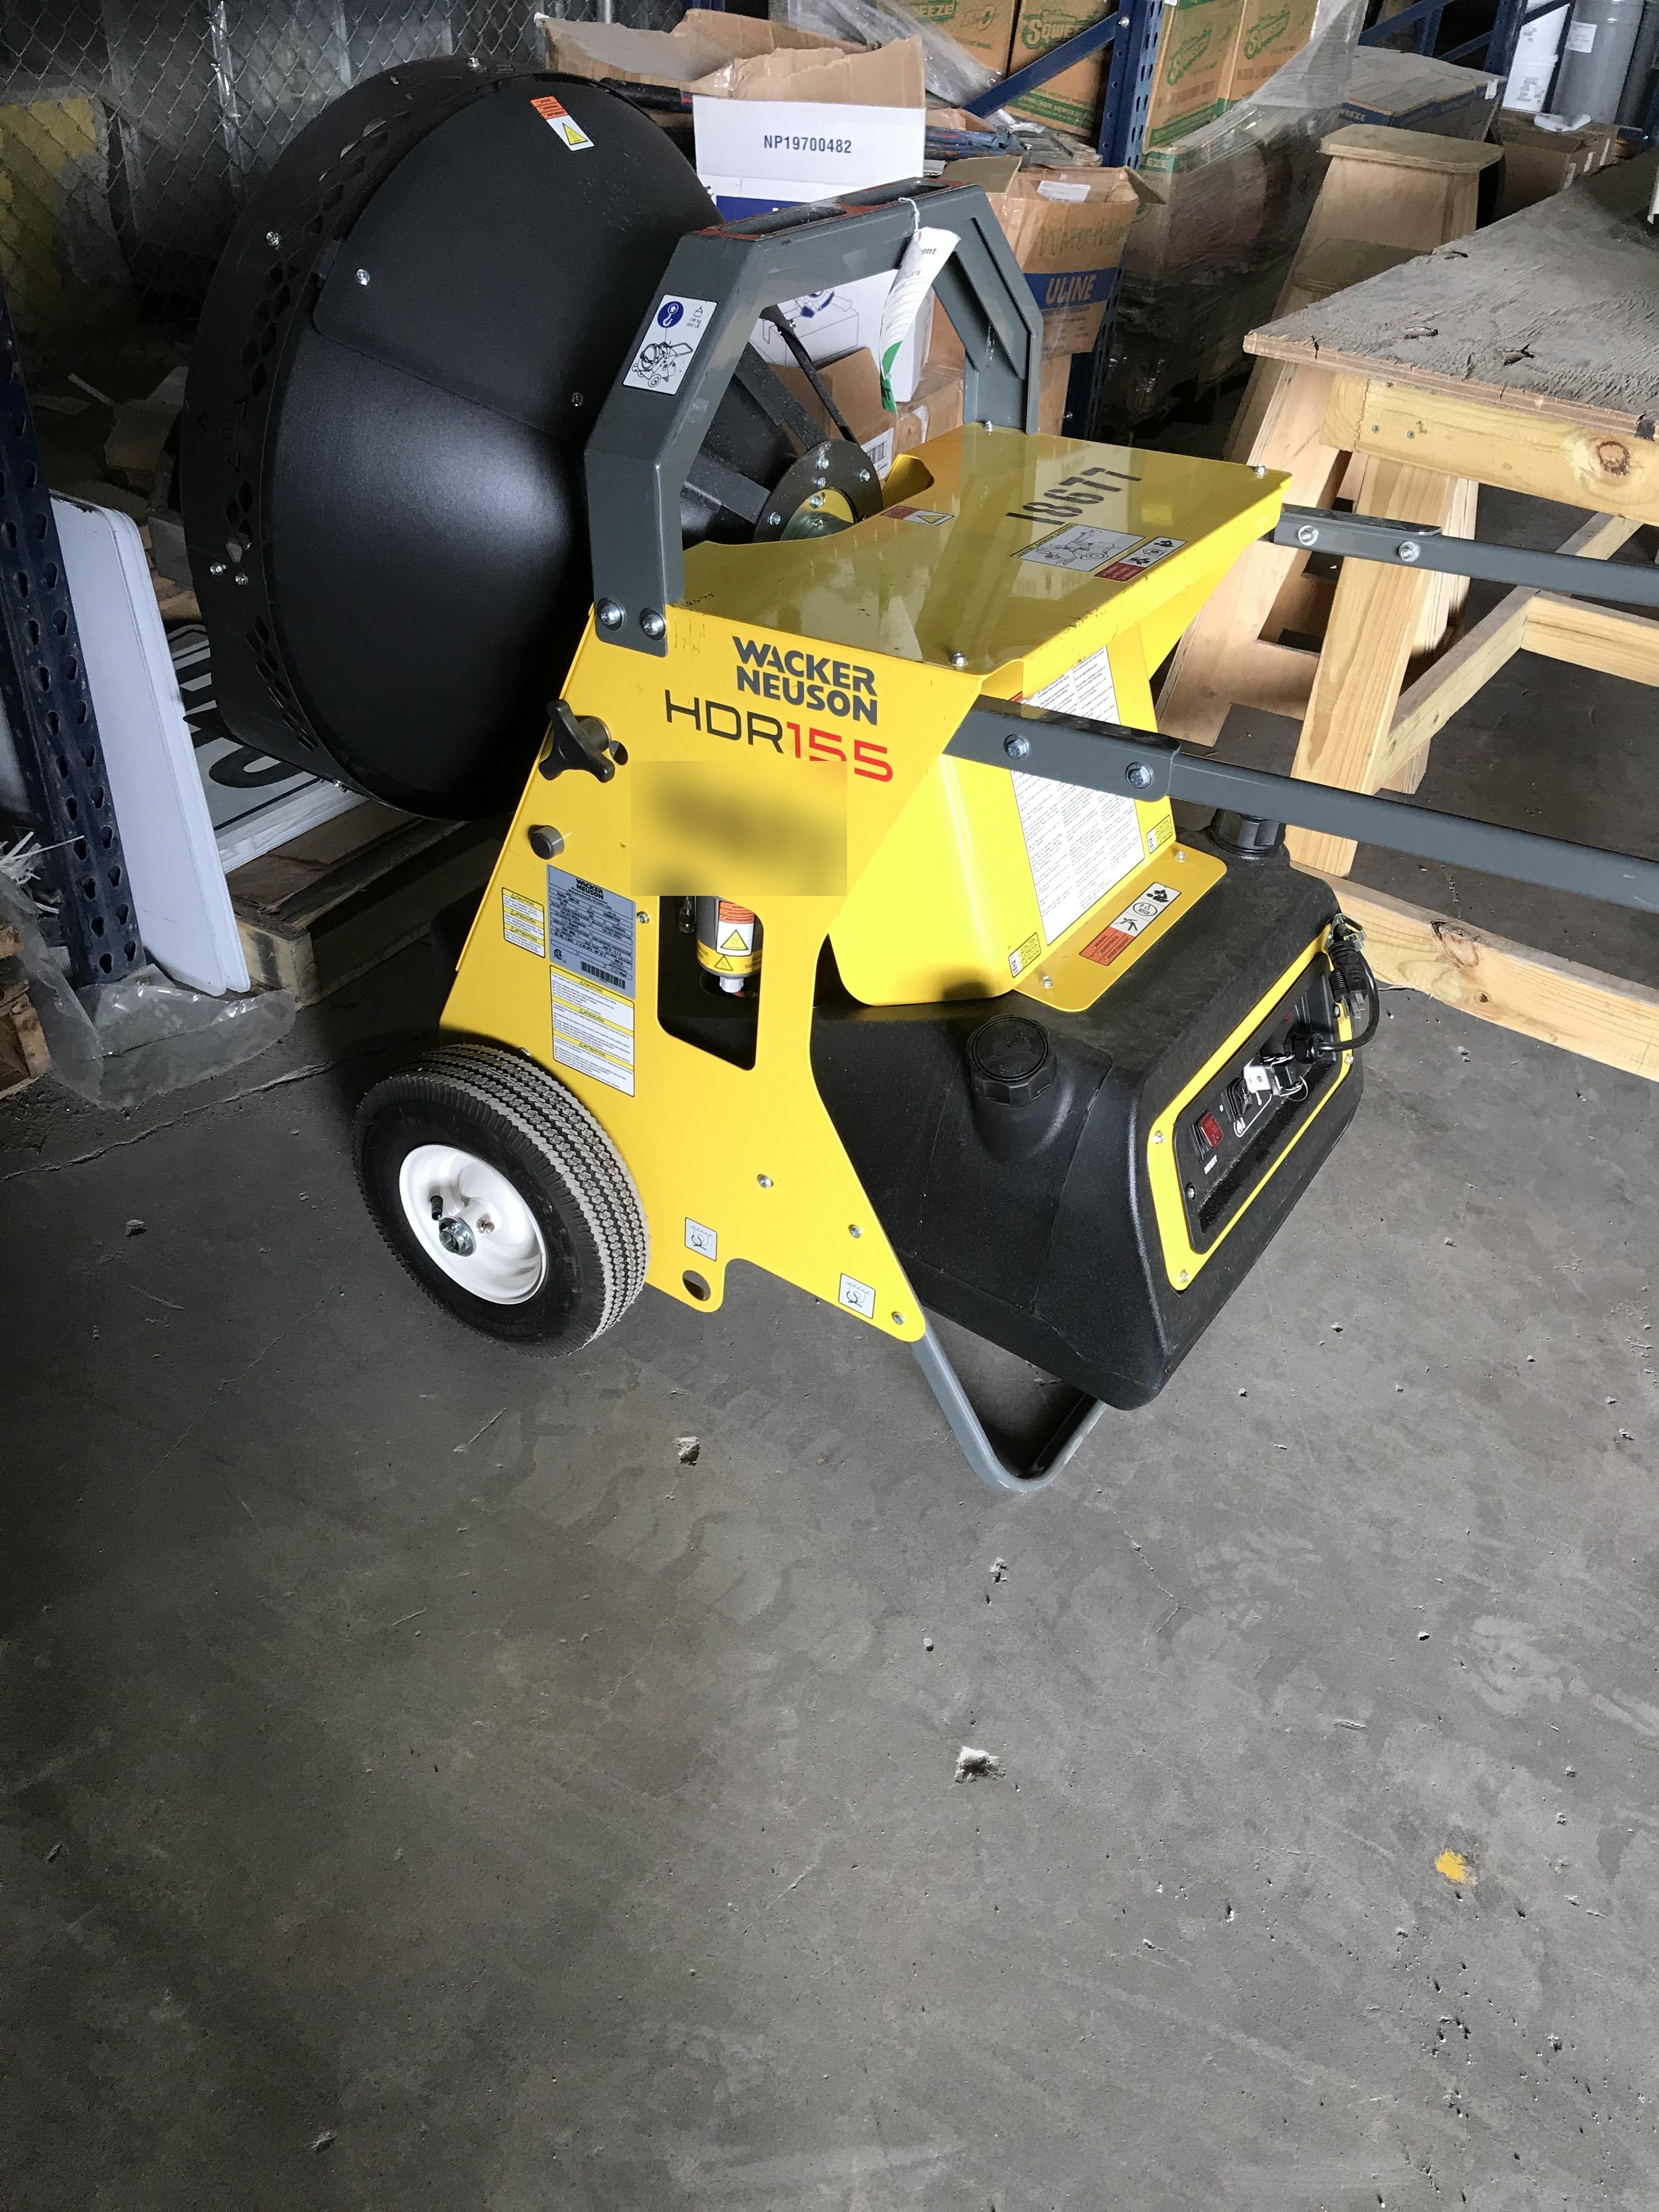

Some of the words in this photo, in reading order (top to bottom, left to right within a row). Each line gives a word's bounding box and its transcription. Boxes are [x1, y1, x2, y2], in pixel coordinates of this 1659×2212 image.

[764, 134, 852, 154] NP19700482
[1046, 274, 1097, 304] ULINE
[732, 636, 878, 697] WACKER
[736, 665, 878, 726] NEUSON
[664, 689, 894, 782] HDR155
[576, 878, 603, 895] WACKER
[577, 884, 603, 900] NEUSON
[516, 895, 534, 907] CAUTION
[583, 981, 603, 994] CAUTION
